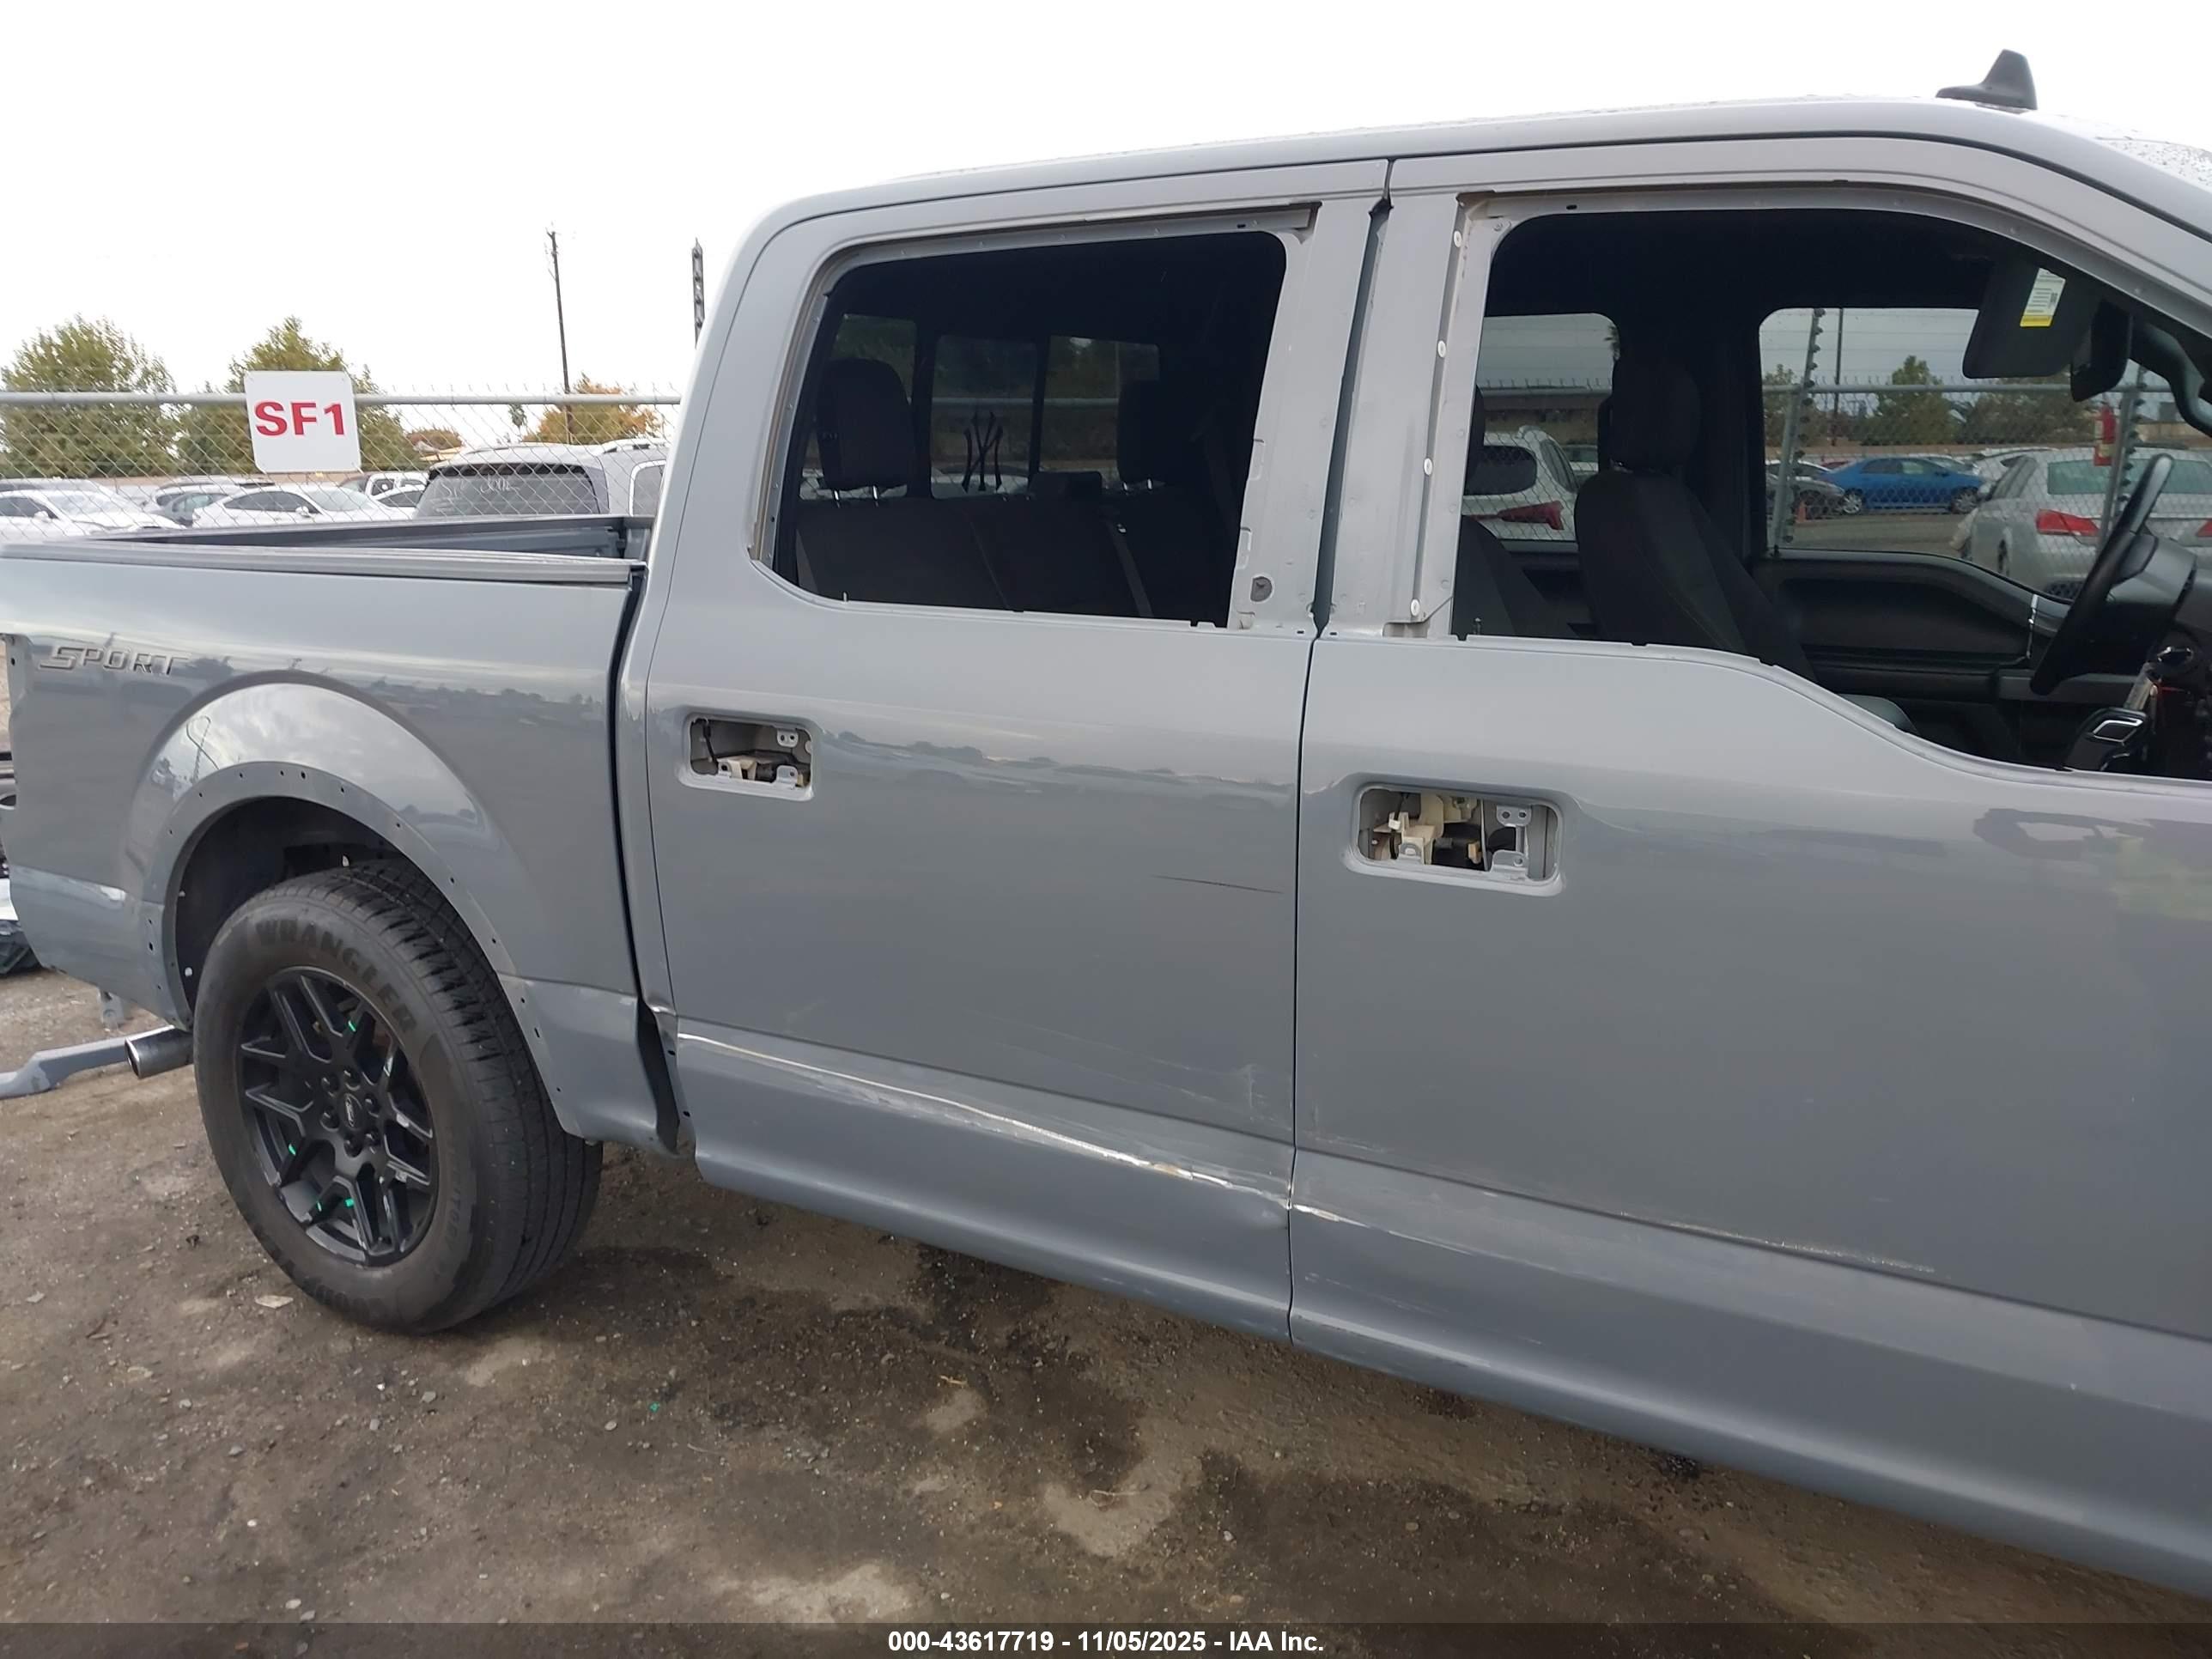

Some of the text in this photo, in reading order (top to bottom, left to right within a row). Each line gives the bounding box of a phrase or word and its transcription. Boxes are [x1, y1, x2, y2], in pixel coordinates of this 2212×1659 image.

[255, 401, 344, 436] SF1
[39, 646, 190, 676] SPORT
[255, 920, 417, 1033] WRANGLER
